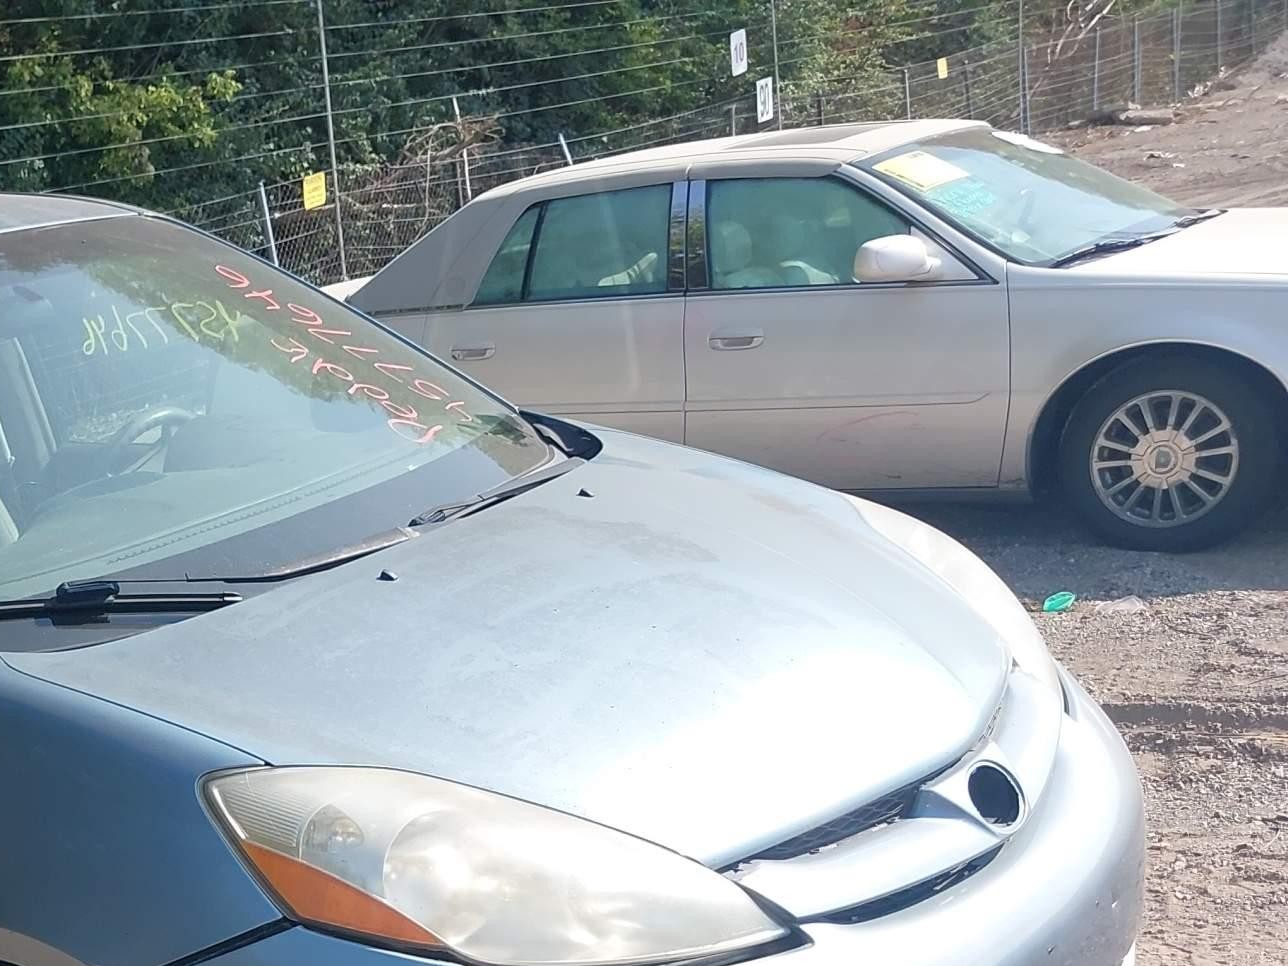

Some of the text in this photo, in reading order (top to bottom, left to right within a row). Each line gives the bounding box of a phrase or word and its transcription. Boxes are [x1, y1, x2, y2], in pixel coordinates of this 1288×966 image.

[734, 42, 745, 64] 10
[759, 83, 770, 118] 90
[215, 264, 473, 422] 45777646
